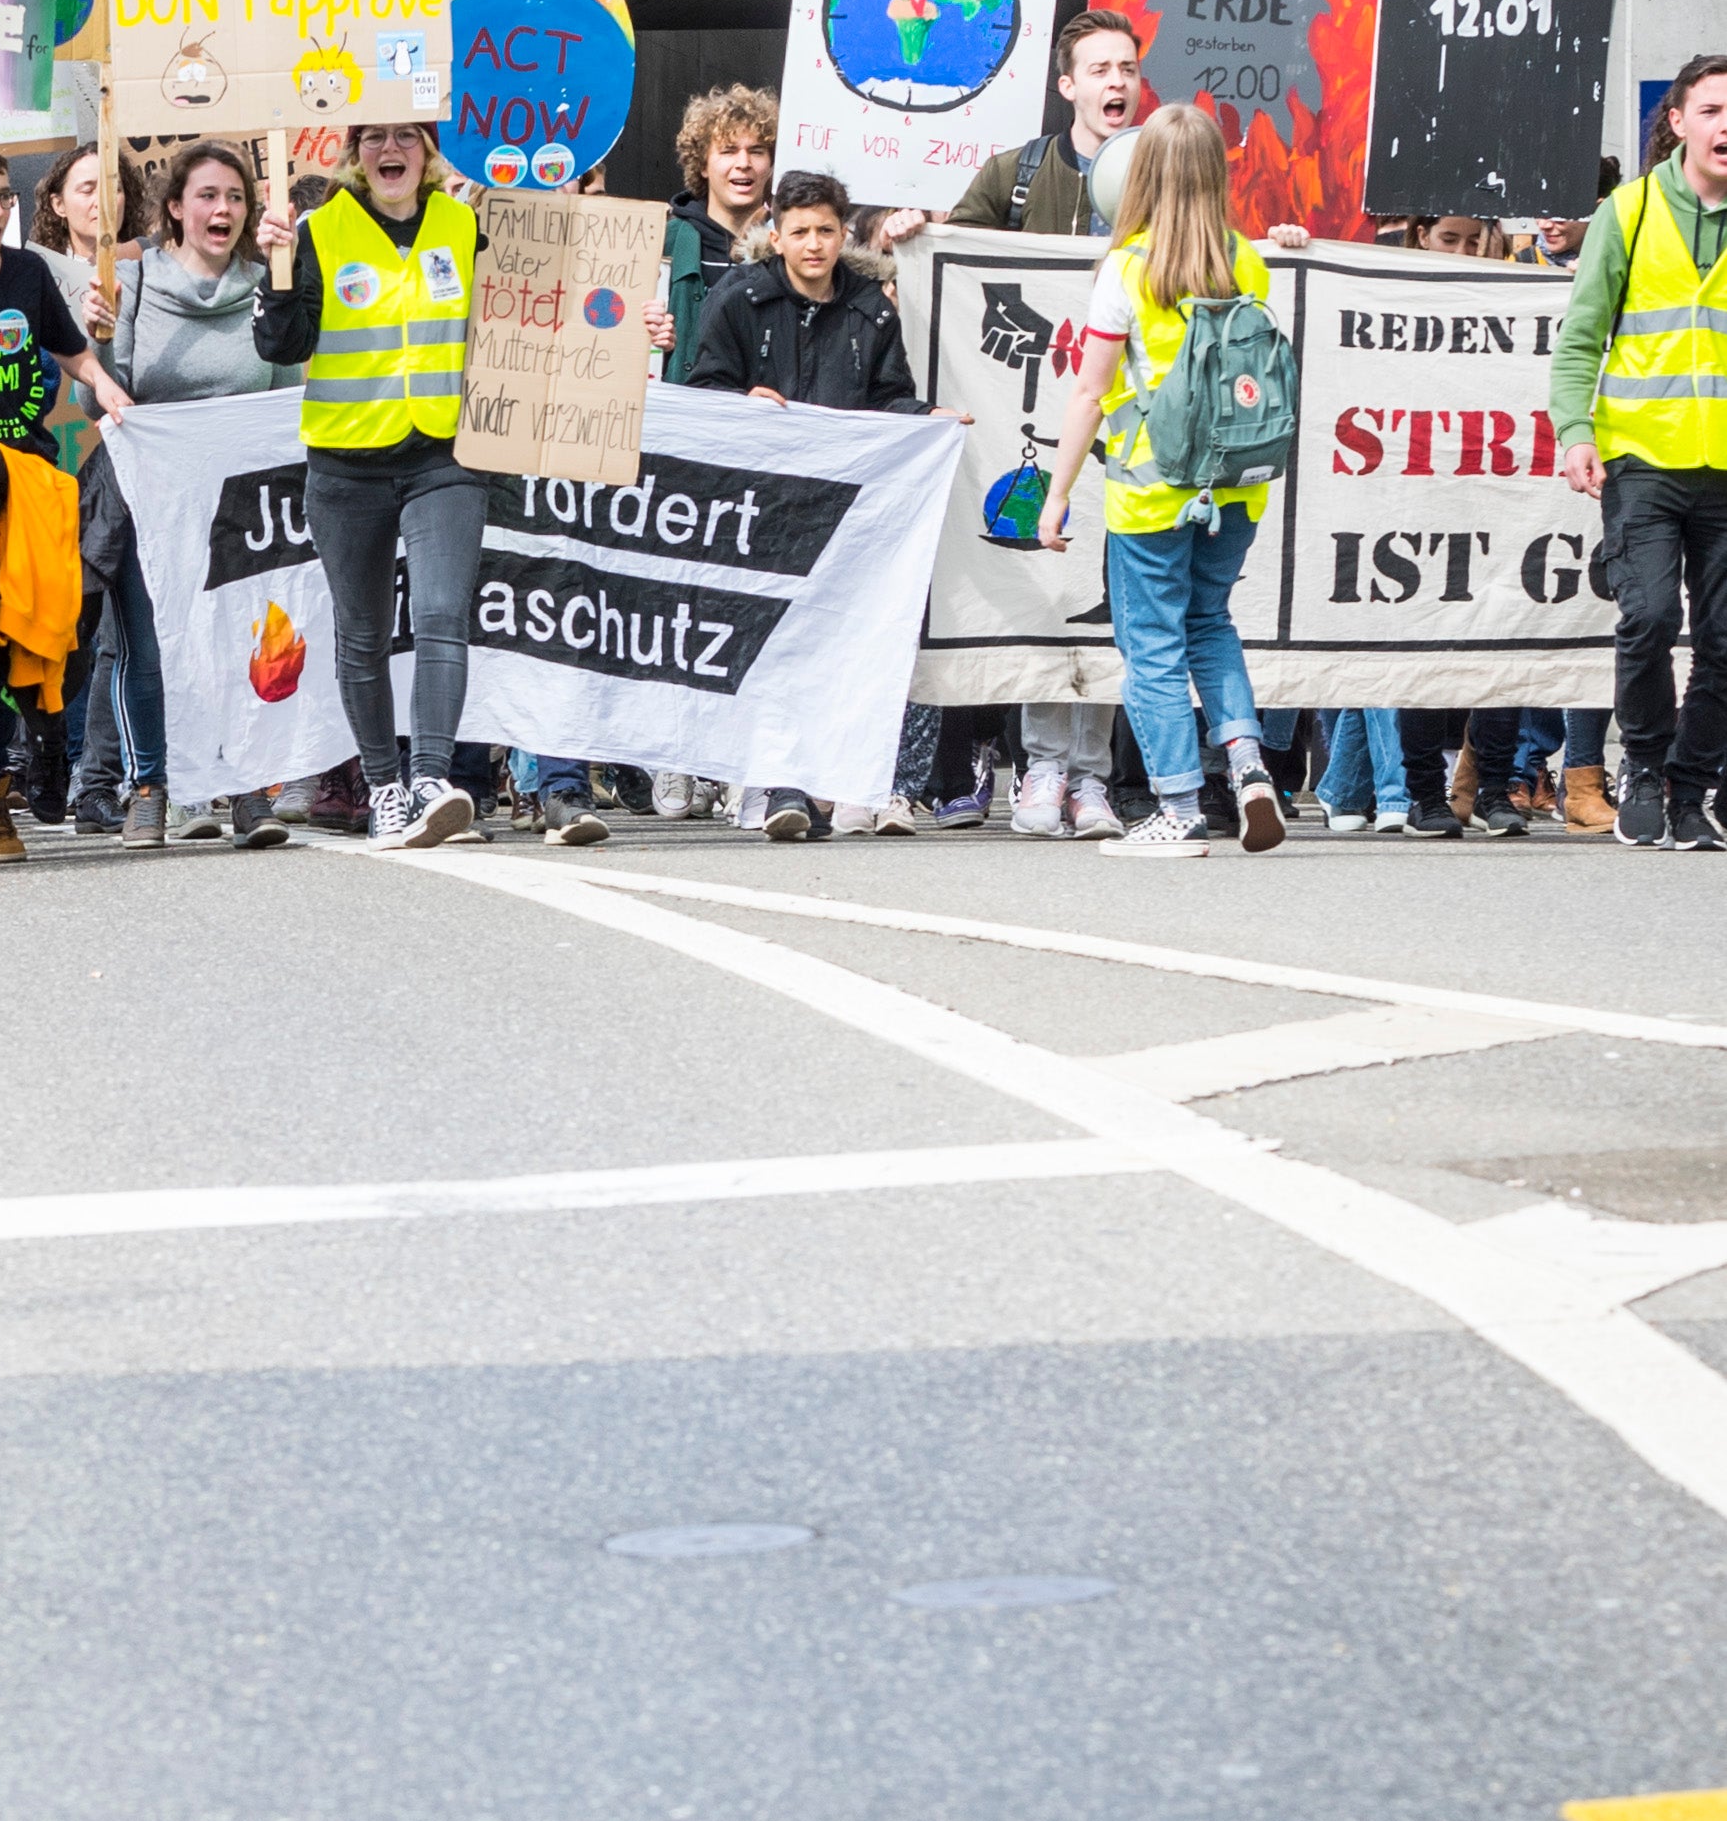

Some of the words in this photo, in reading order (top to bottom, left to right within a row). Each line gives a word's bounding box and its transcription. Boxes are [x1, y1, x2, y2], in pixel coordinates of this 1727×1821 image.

[27, 34, 51, 61] for
[463, 26, 584, 74] ACT
[1185, 36, 1256, 56] gestorben
[457, 92, 591, 147] NOW
[862, 134, 900, 159] VOR
[486, 198, 656, 251] FAMILIENDRAMA:
[491, 242, 552, 277] Vater
[572, 249, 643, 290] Staat
[480, 275, 567, 334] tötet
[470, 326, 615, 381] Muttererde
[1339, 309, 1516, 356] REDEN
[460, 380, 520, 438] Kinder
[531, 398, 639, 476] verzweifelt
[1327, 531, 1491, 604] IST
